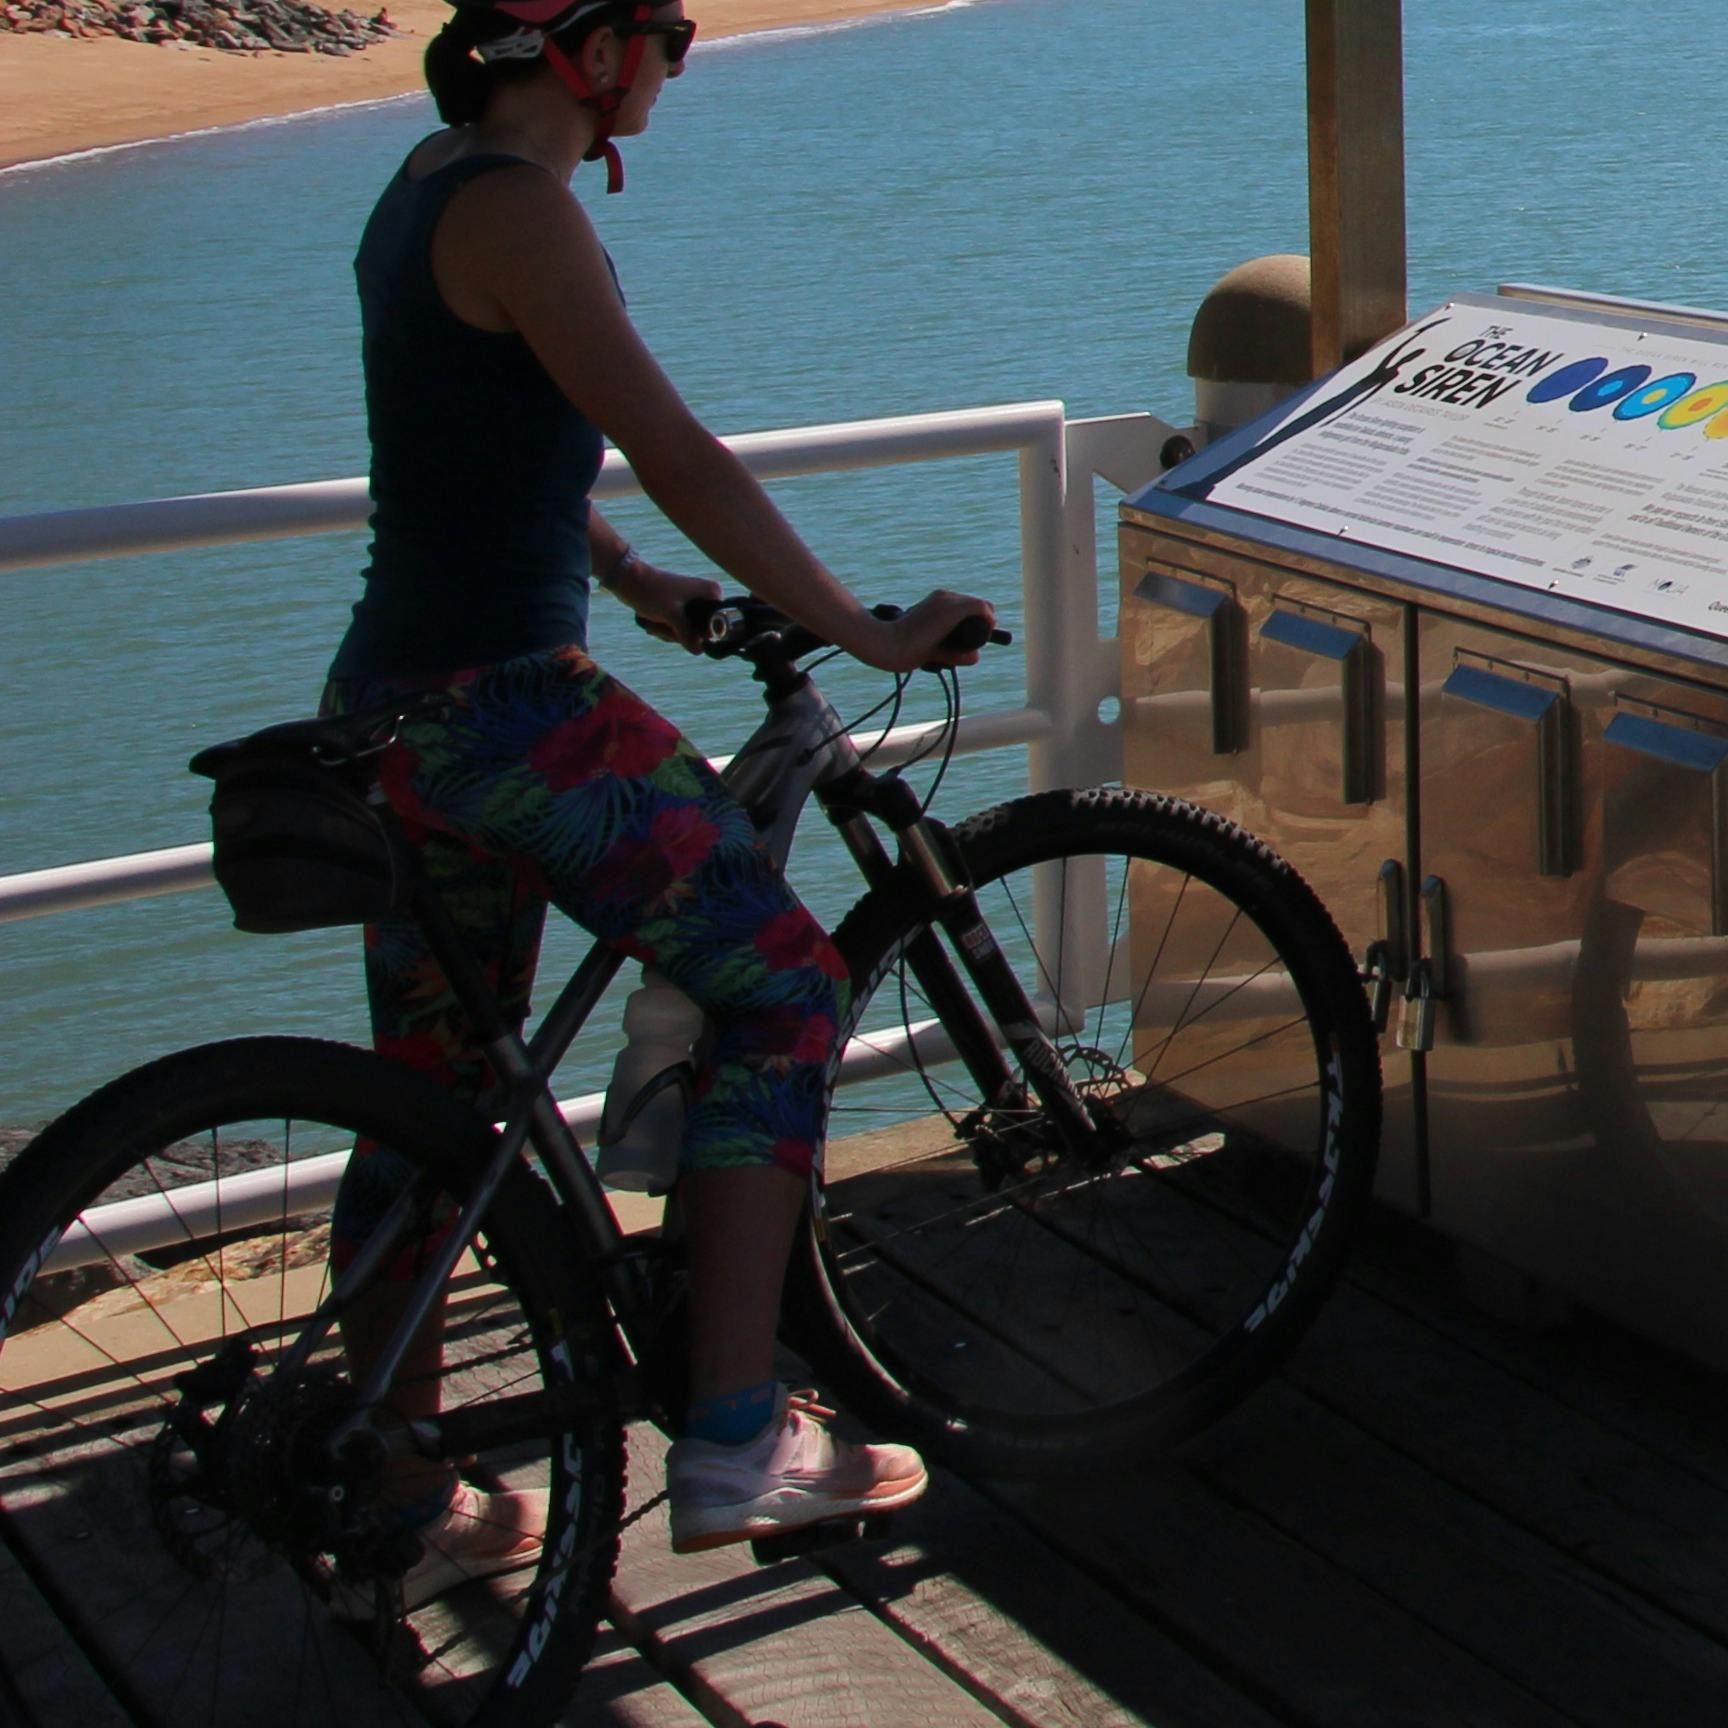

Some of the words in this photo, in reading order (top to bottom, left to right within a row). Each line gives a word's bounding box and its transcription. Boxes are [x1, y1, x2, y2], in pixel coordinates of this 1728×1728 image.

[1480, 325, 1513, 339] THE
[1443, 338, 1564, 377] OCEAN
[1394, 364, 1522, 409] SIREN
